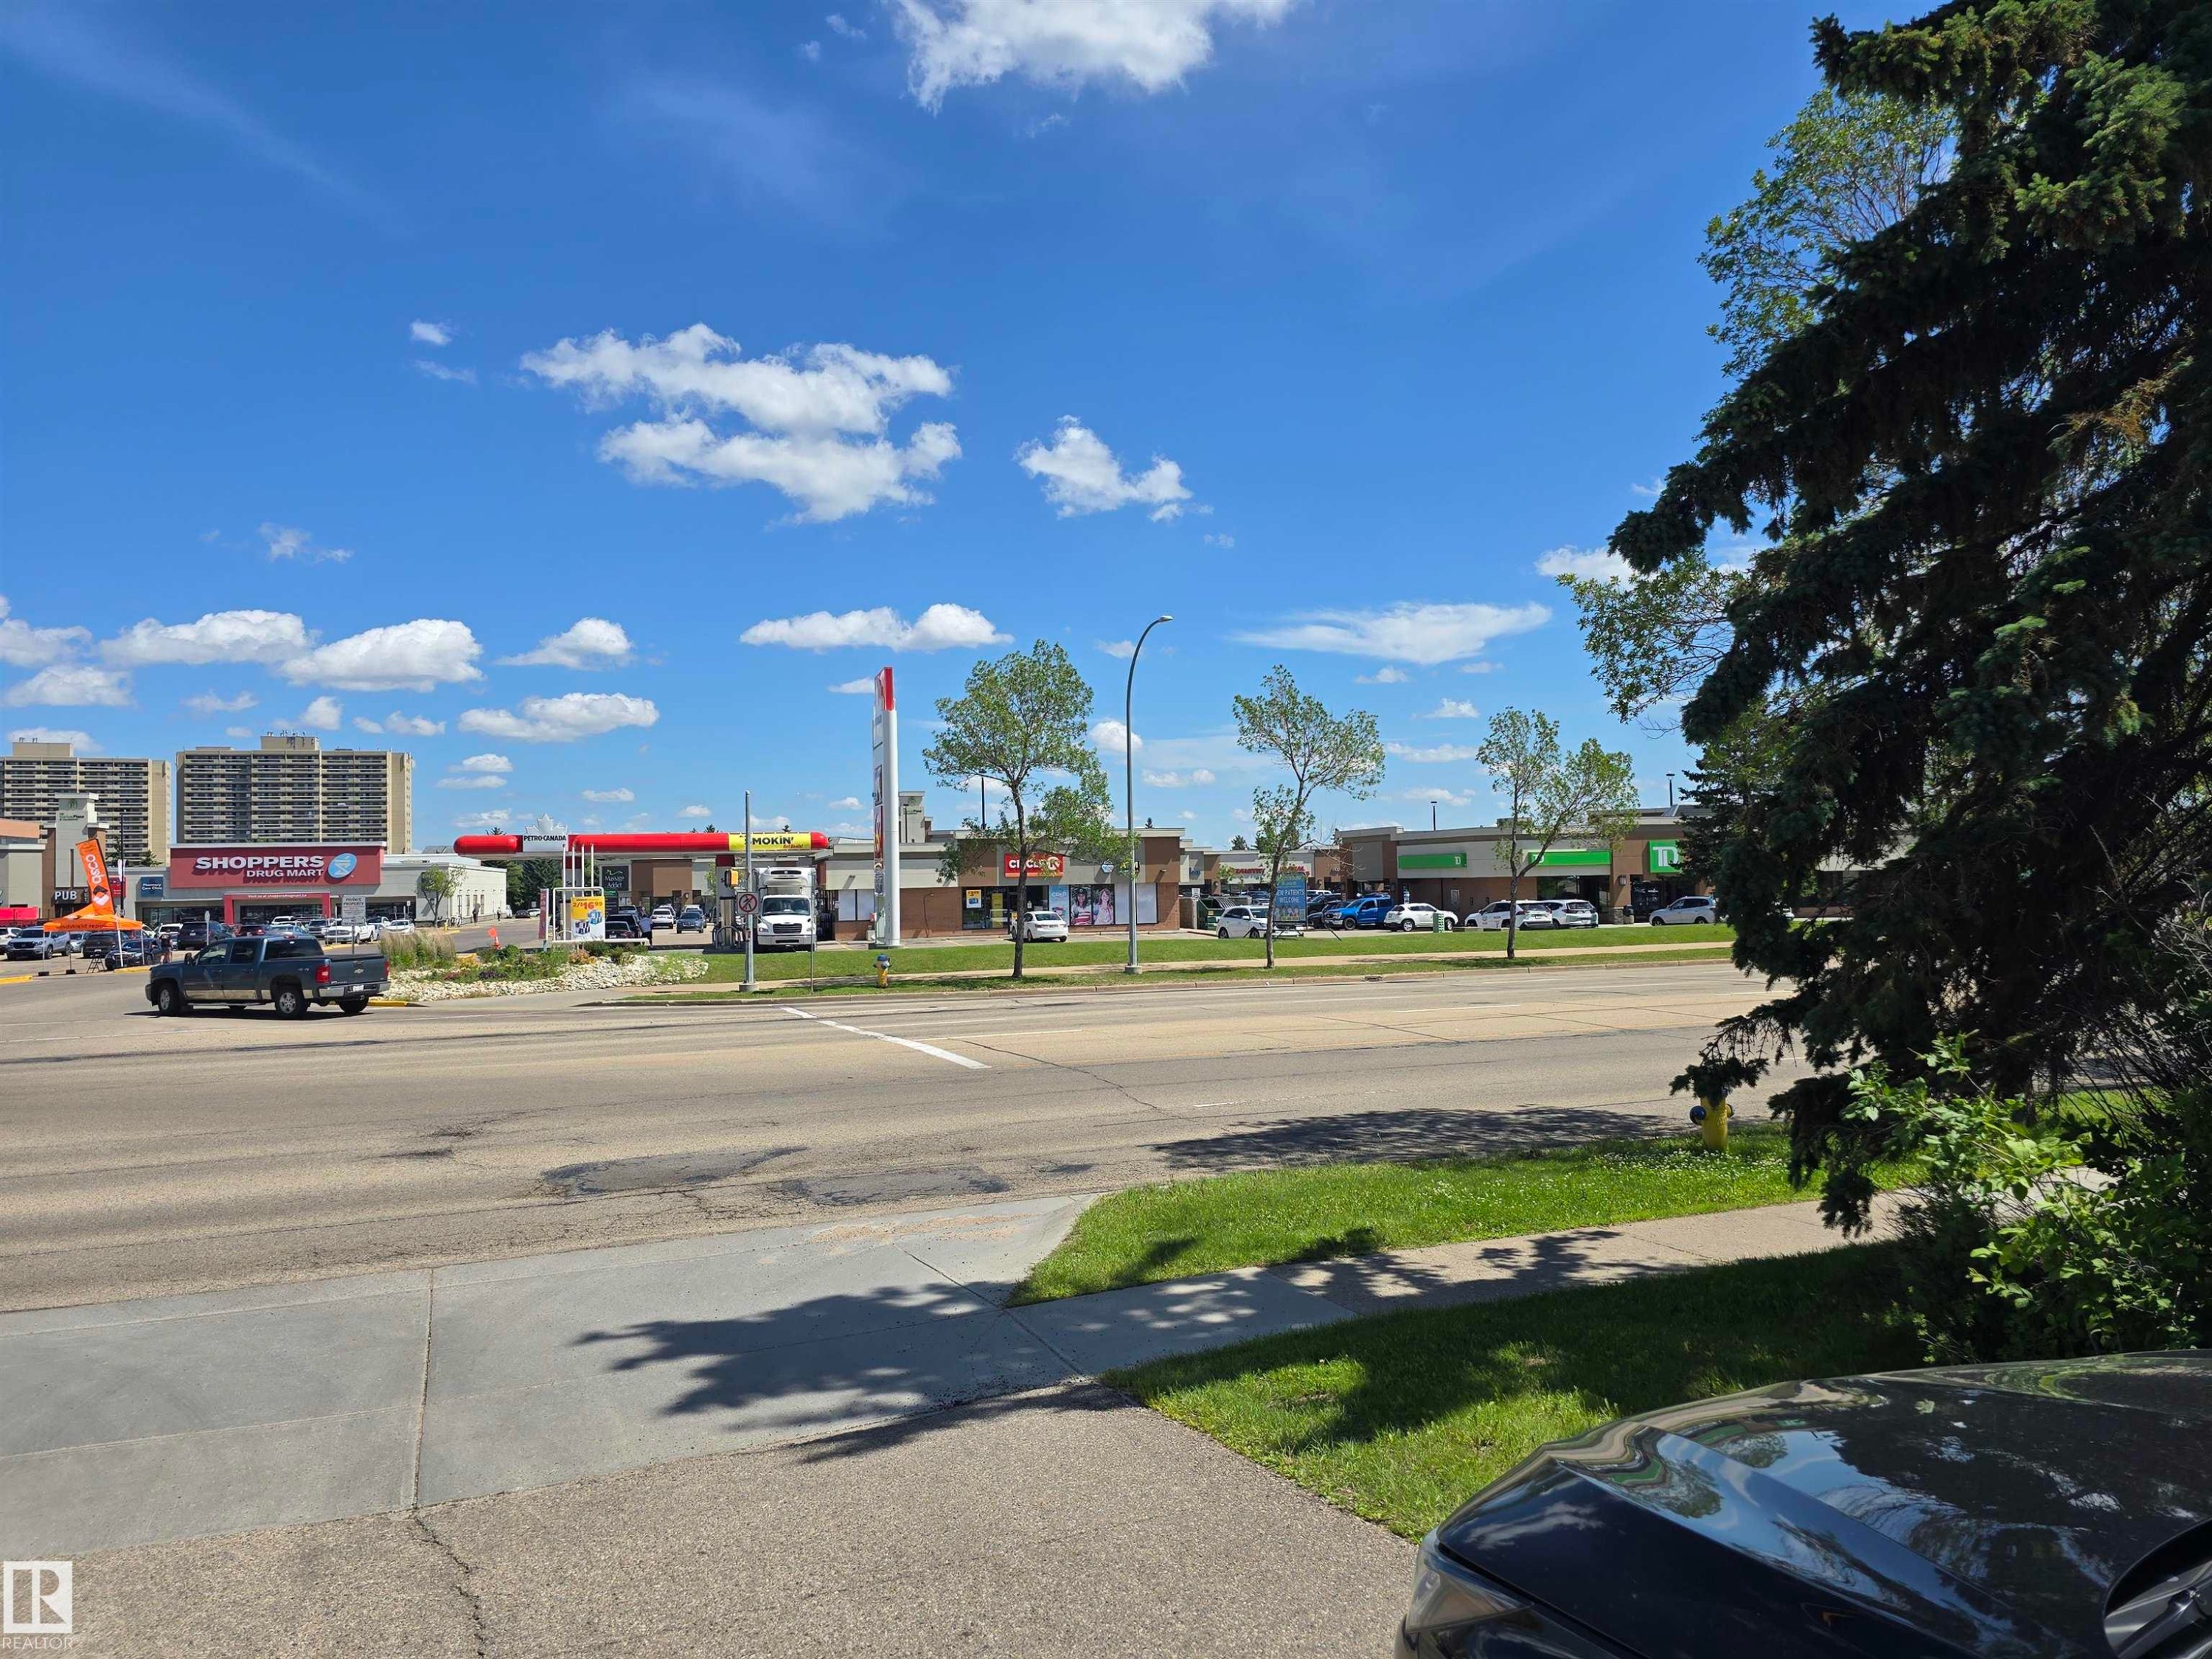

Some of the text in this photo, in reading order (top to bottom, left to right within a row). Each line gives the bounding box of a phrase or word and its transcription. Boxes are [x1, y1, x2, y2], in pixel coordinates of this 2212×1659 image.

[195, 855, 324, 869] SHOPPERS
[1652, 846, 1679, 867] TD
[246, 869, 324, 877] DRUG MART
[55, 891, 77, 900] PUB
